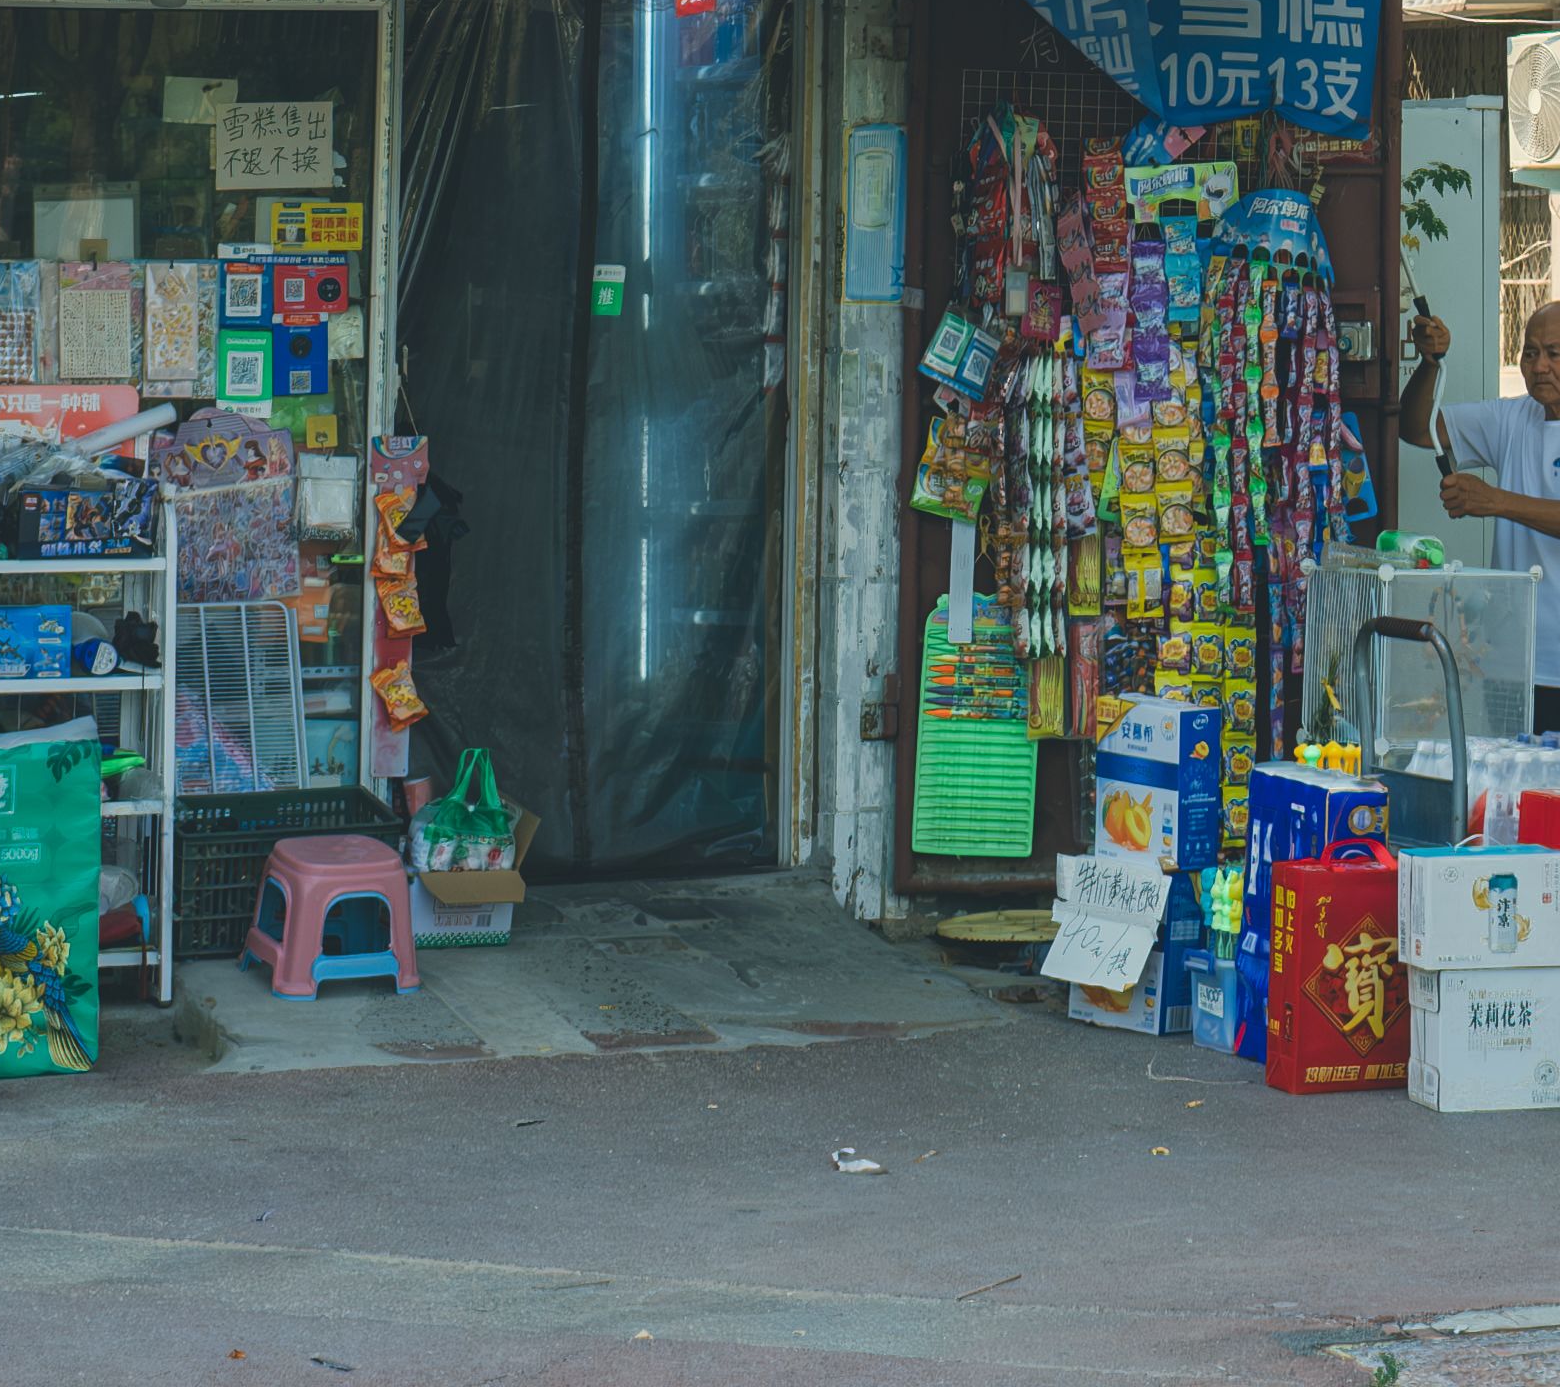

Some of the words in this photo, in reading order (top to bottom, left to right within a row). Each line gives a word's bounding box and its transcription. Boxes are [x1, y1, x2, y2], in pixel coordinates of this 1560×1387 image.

[222, 105, 327, 142] 雪糕售出
[223, 145, 322, 178] 不退不换
[1468, 1001, 1534, 1030] 茉莉花茶
